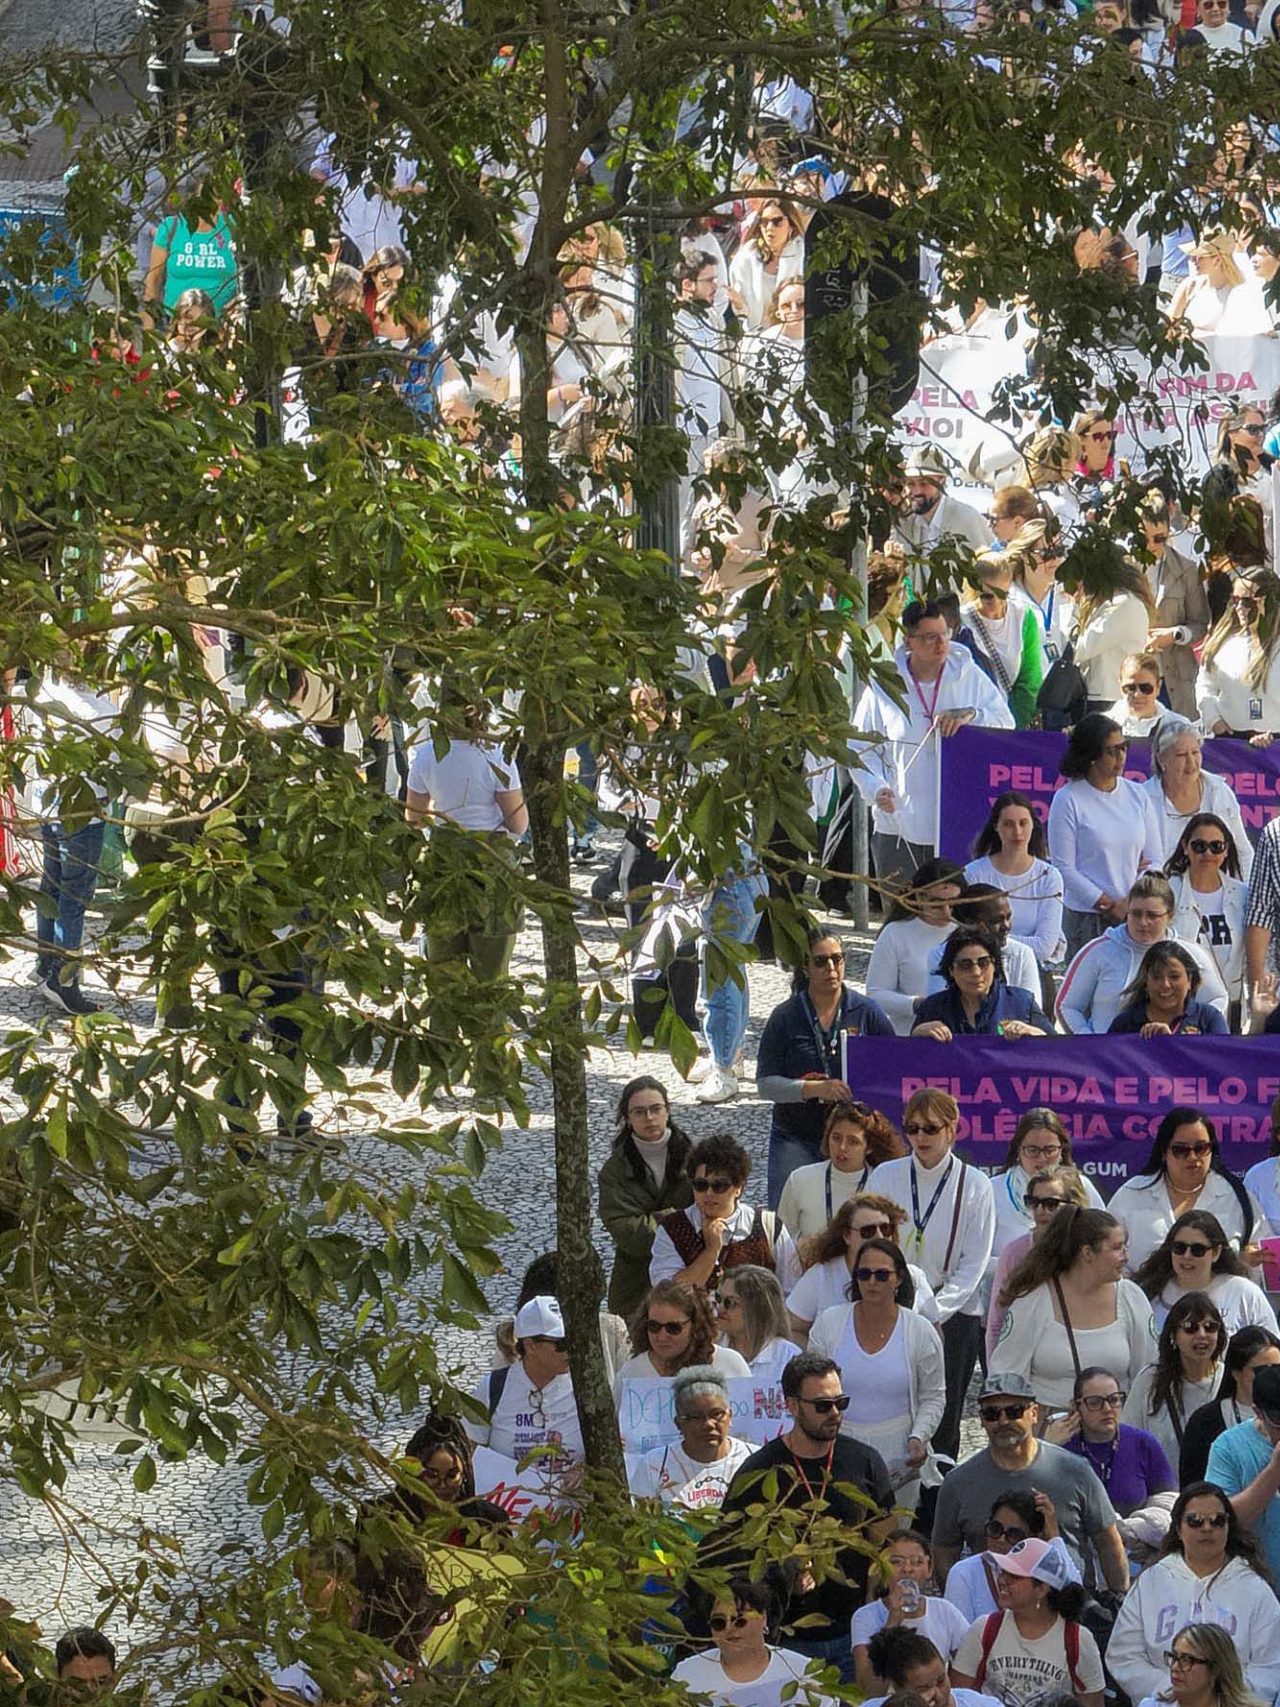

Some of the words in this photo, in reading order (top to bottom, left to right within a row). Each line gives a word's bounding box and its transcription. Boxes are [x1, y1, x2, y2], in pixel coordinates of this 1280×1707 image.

[185, 243, 218, 256] GRL
[176, 254, 226, 269] POWER
[1215, 371, 1257, 393] DA
[1011, 1076, 1099, 1103] VIDA
[1115, 1077, 1138, 1104] E
[1148, 1077, 1247, 1105] PELO
[991, 1656, 1063, 1681] EVERYTHING
